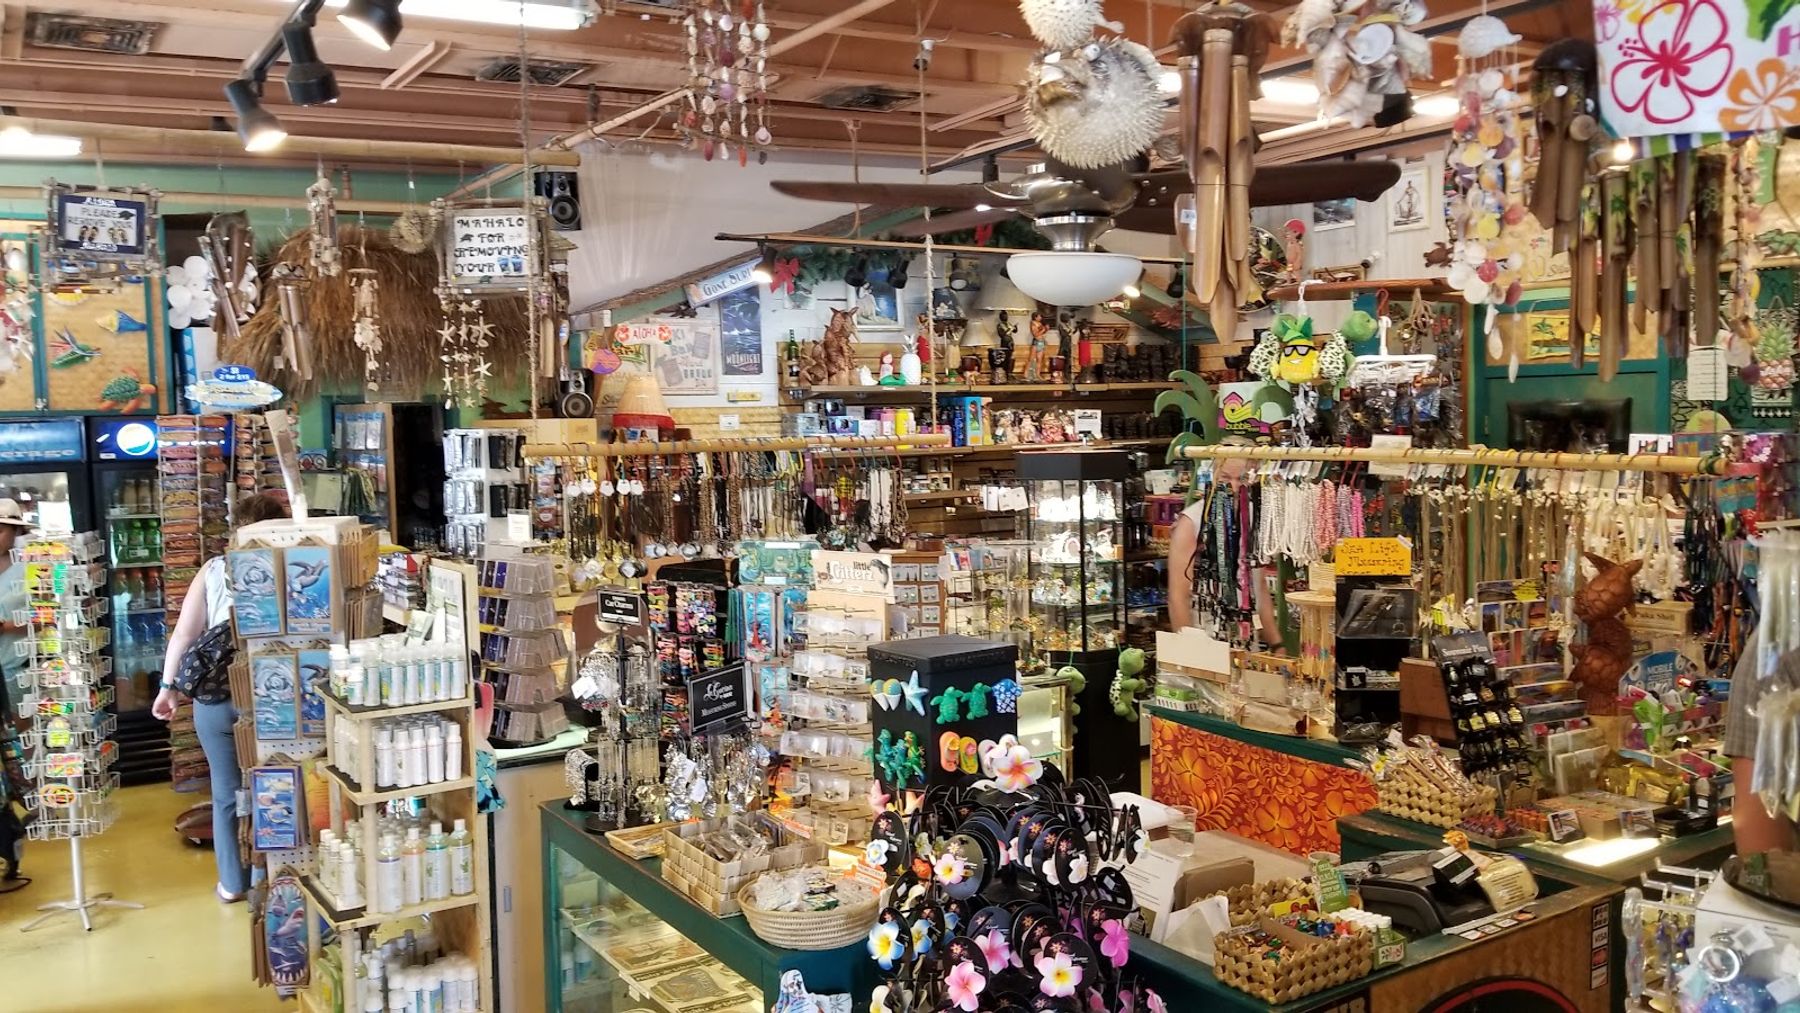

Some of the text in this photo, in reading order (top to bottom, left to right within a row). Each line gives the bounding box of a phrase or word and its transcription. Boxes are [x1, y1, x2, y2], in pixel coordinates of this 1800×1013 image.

[457, 217, 525, 229] MAHALO
[477, 232, 505, 243] FOR
[455, 262, 496, 273] YOUR
